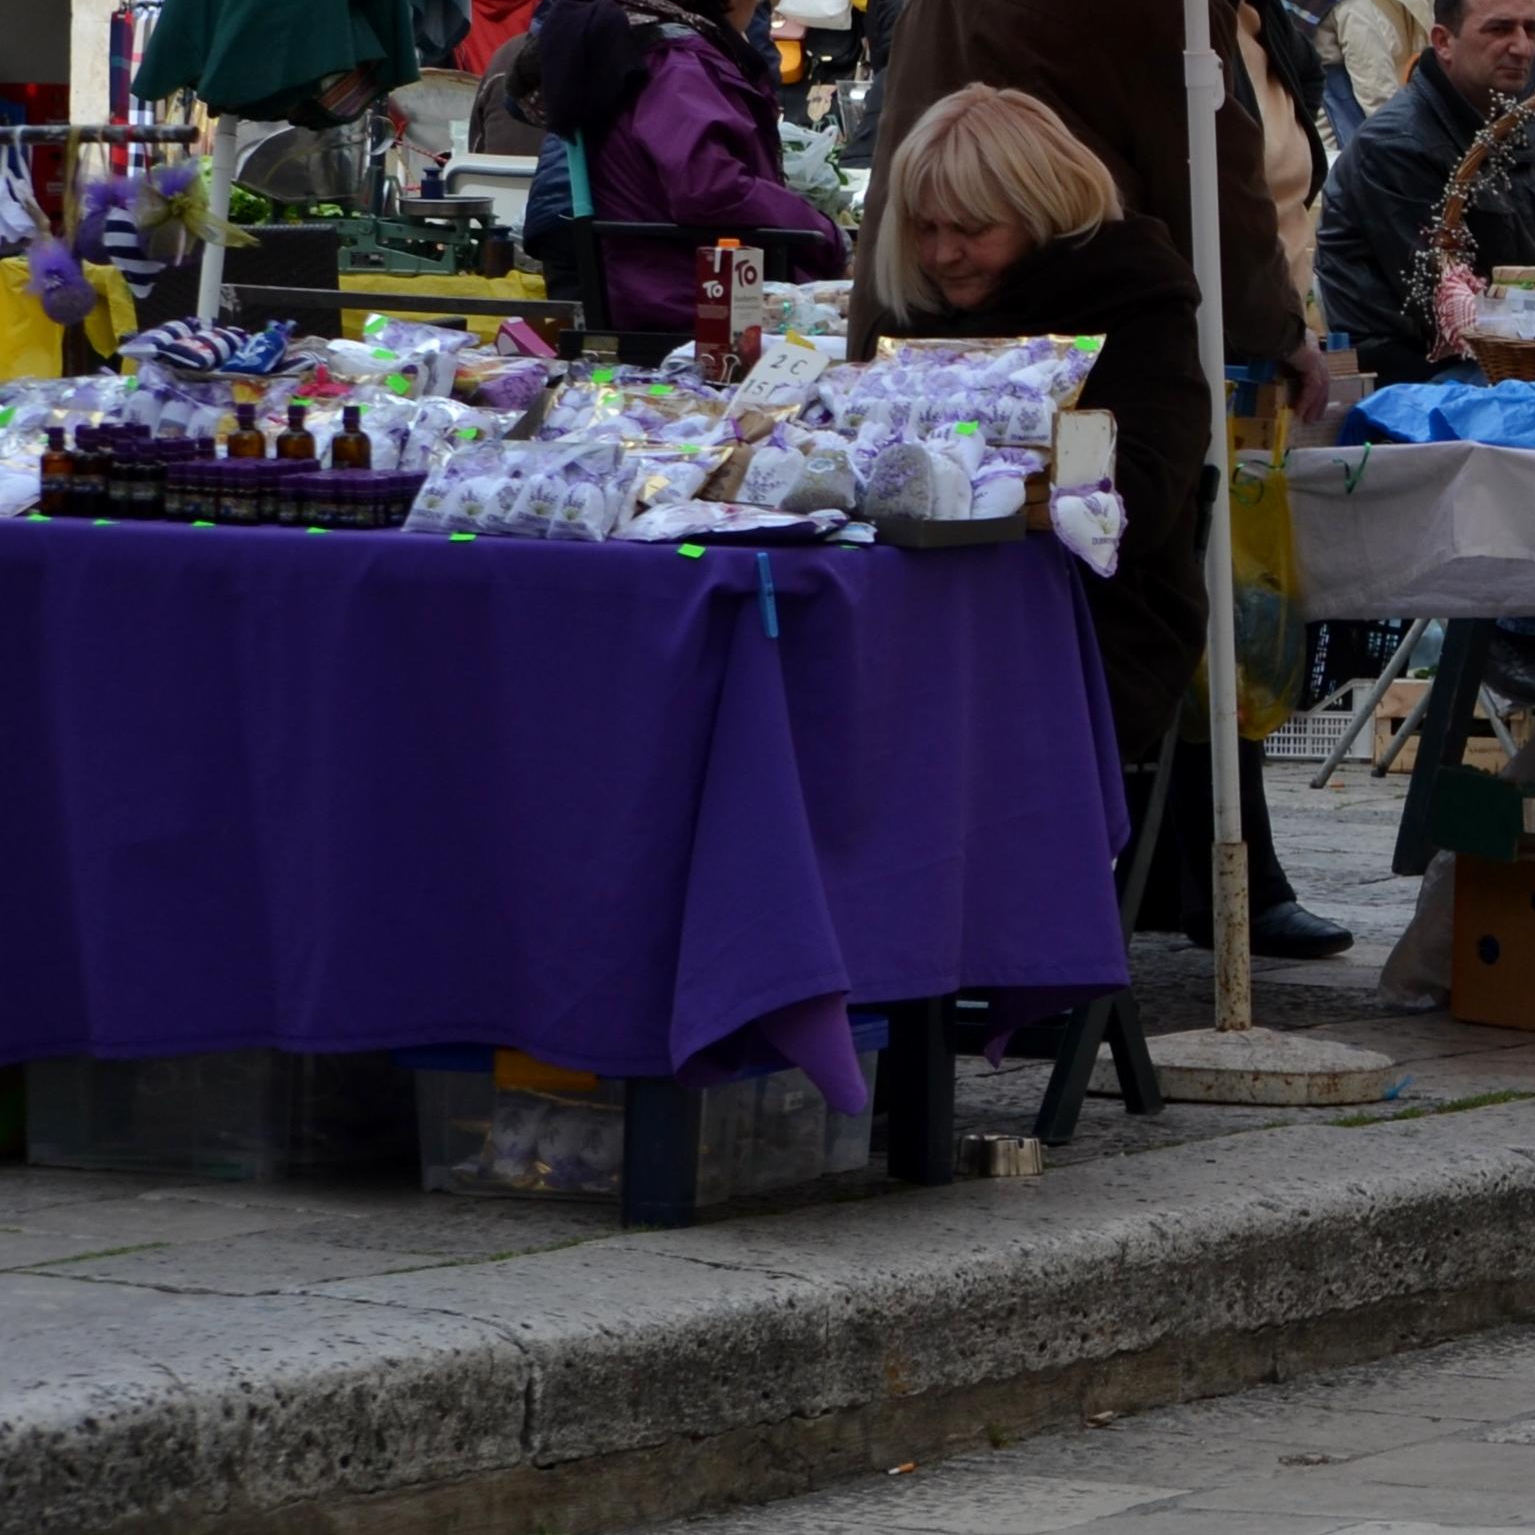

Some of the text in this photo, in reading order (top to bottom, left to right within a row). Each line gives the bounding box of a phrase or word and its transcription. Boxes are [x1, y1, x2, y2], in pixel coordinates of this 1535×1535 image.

[735, 259, 758, 288] TO
[702, 280, 724, 299] TO
[770, 353, 788, 370] 2
